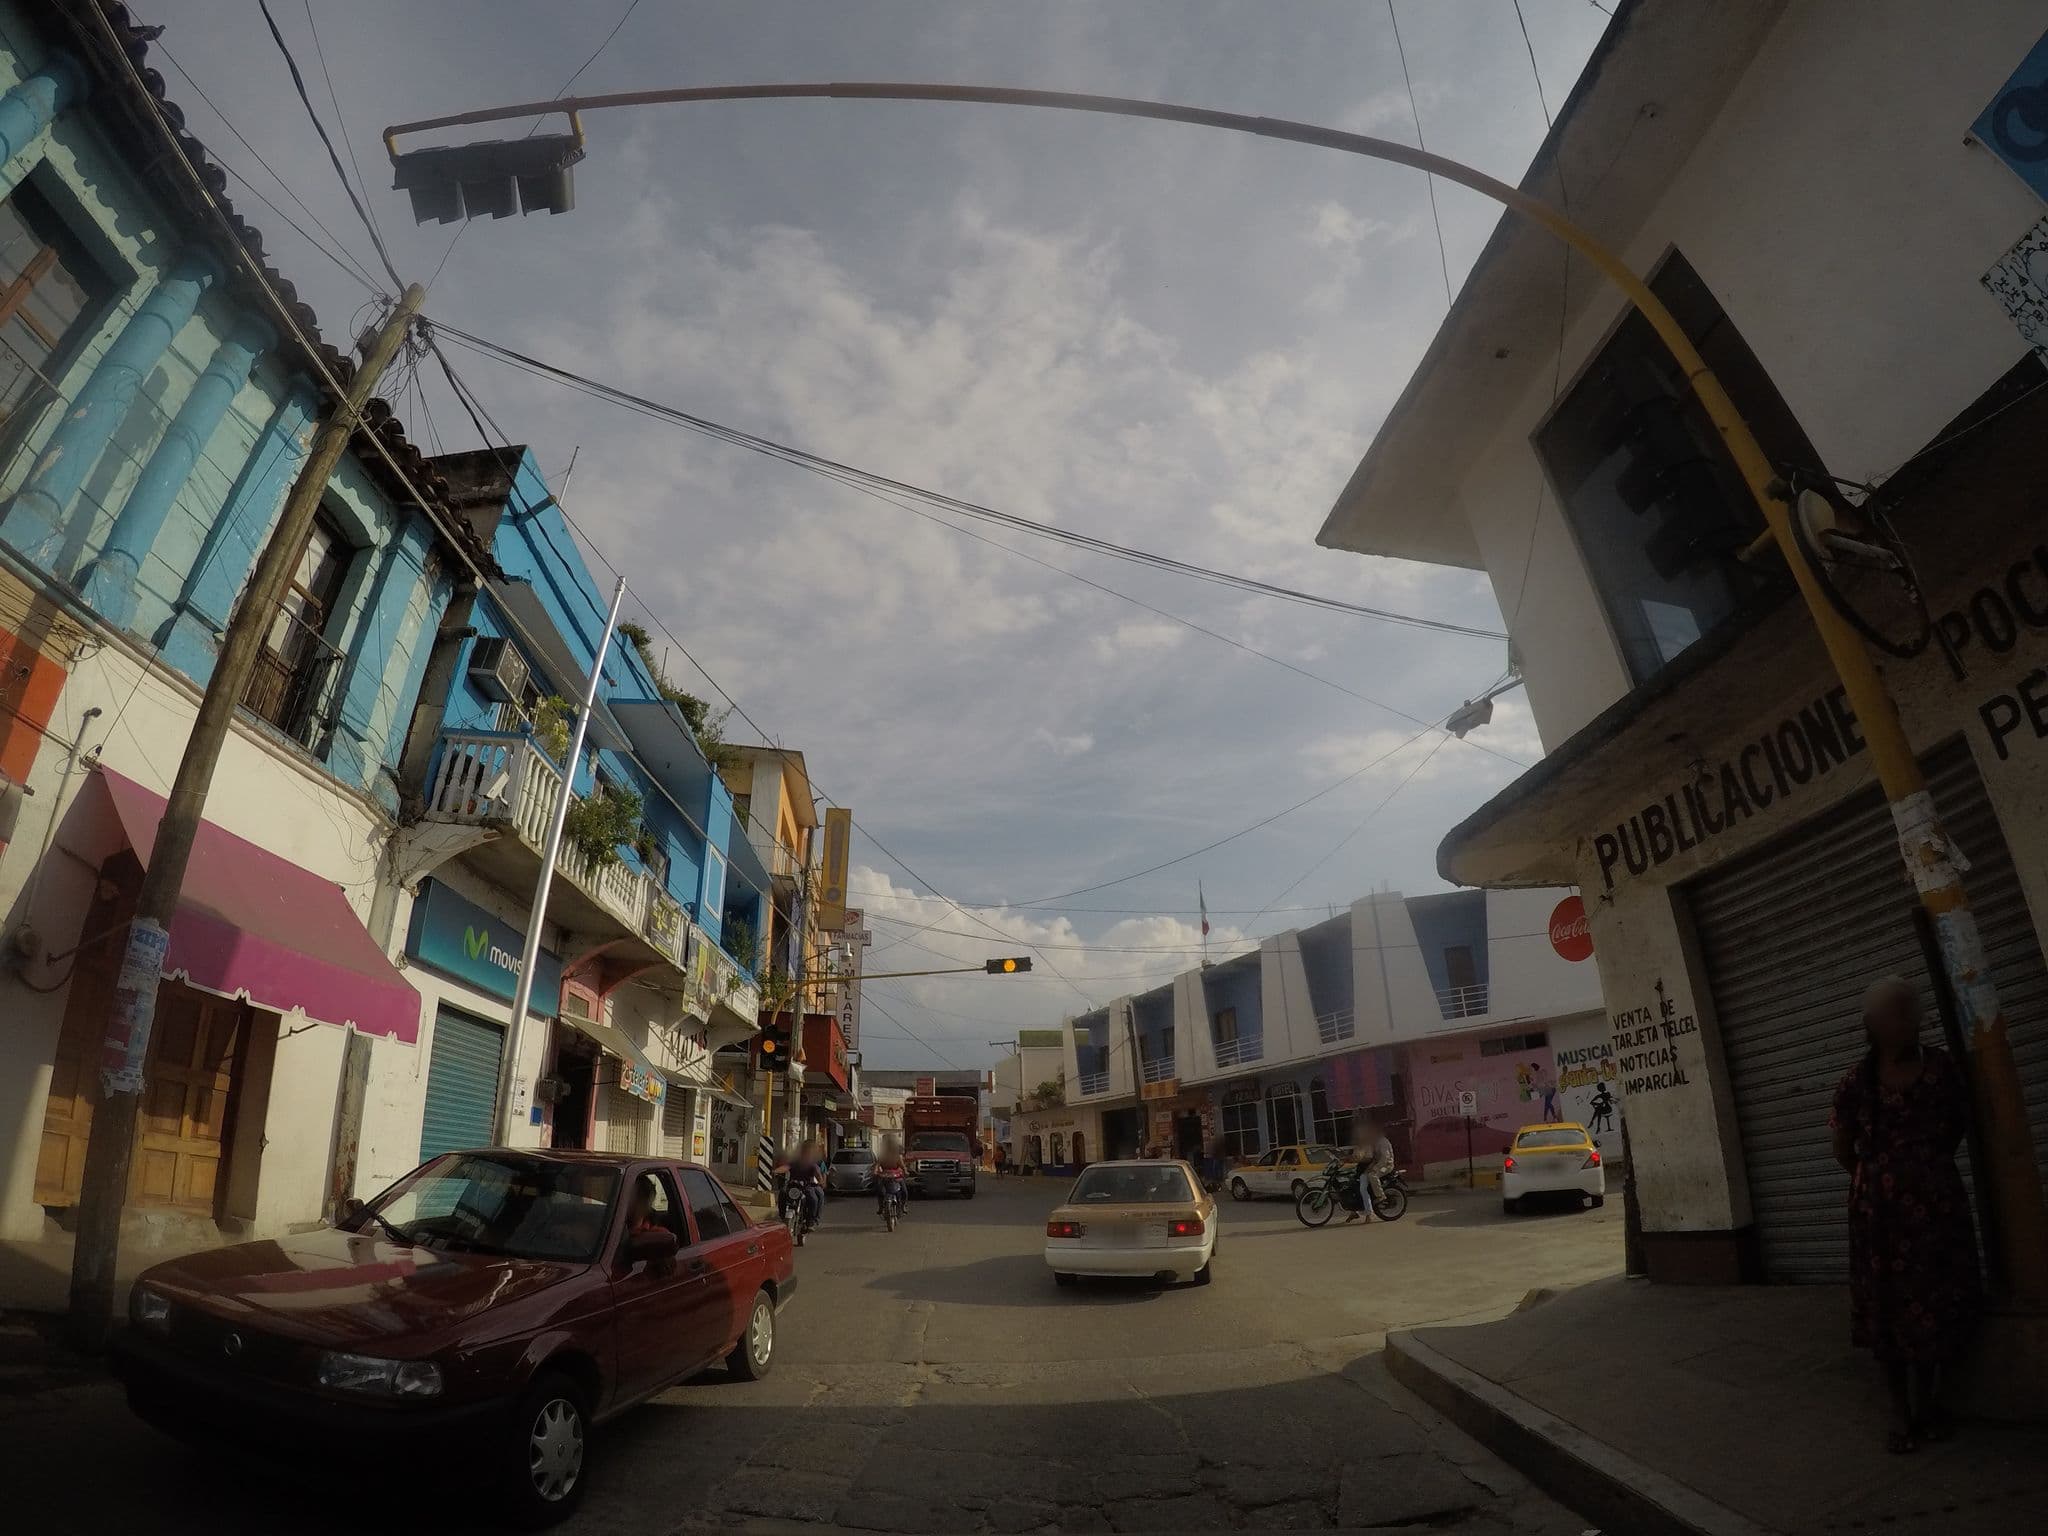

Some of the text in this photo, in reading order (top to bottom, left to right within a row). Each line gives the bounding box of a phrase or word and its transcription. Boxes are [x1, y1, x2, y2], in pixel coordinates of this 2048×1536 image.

[1594, 684, 1867, 890] PUBLICACIONE
[489, 946, 525, 976] movis
[1612, 998, 1675, 1030] VENTA DE
[1612, 1015, 1697, 1051] TARJETA TELCEL
[1619, 1045, 1678, 1073] NOTICIAS
[1624, 1069, 1690, 1096] IMPARCIAL
